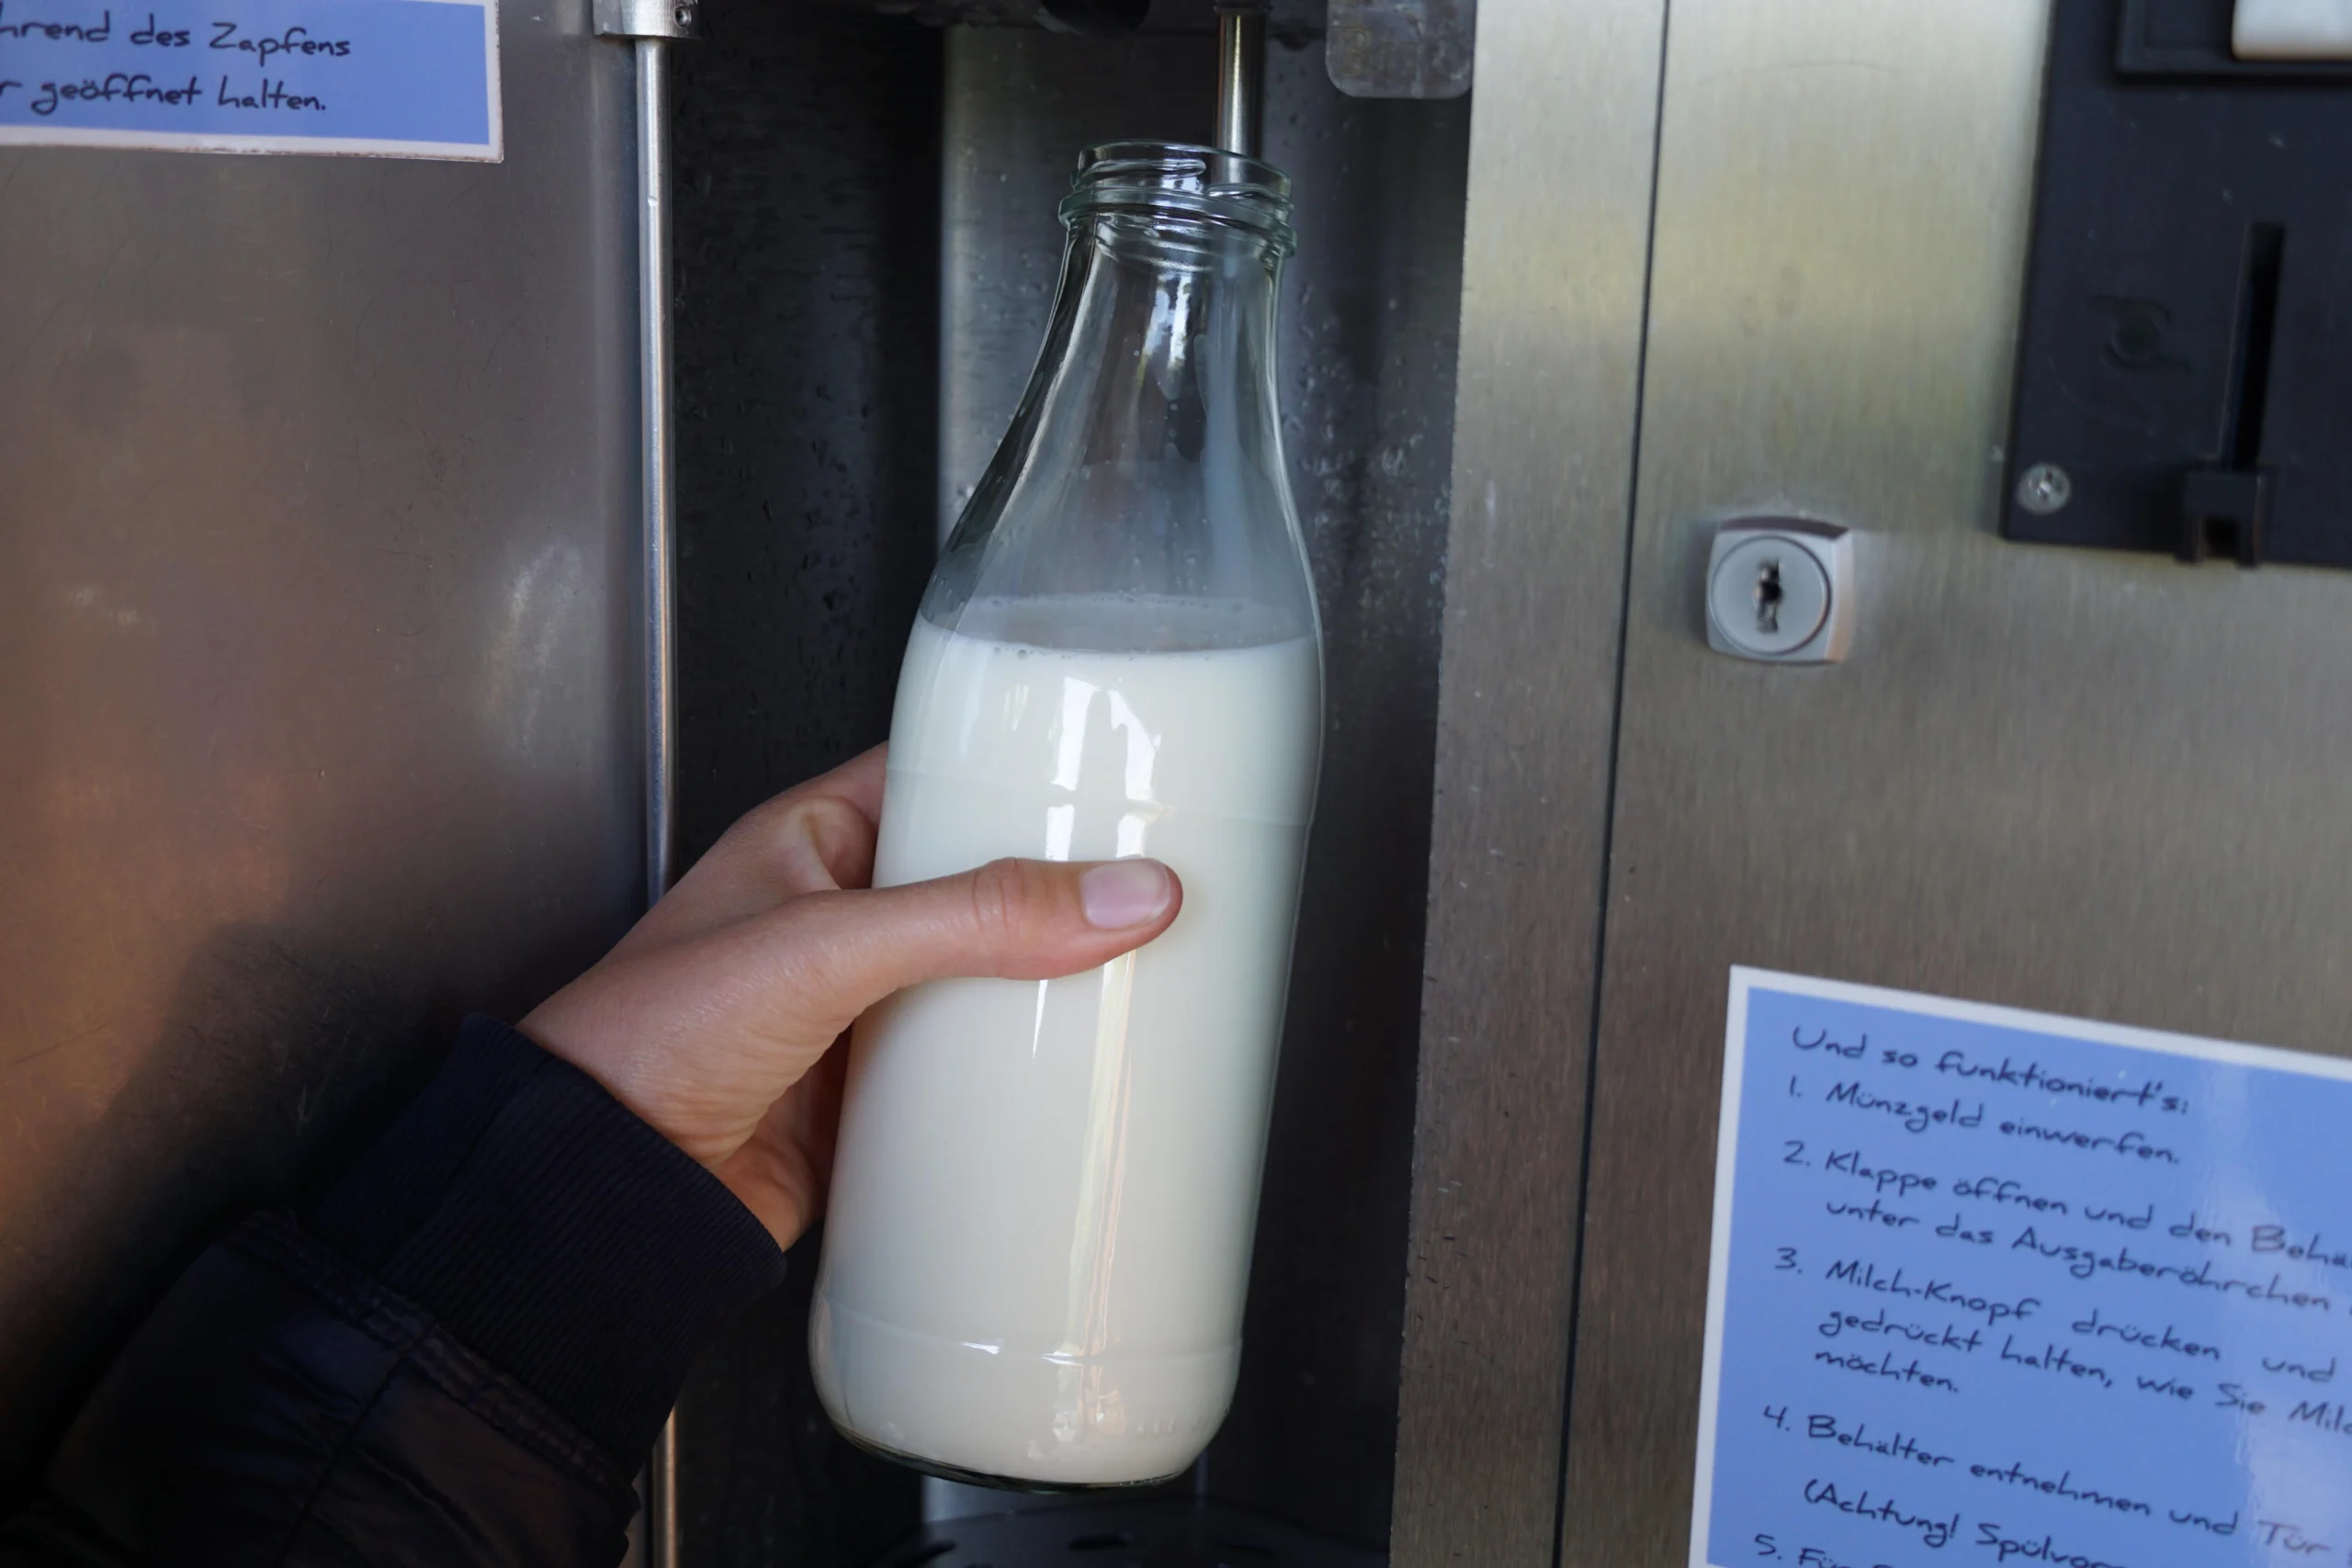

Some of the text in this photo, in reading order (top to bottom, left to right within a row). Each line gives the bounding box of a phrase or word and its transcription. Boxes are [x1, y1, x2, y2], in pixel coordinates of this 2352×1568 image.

[130, 12, 191, 48] des
[209, 22, 351, 68] Zapfens
[30, 73, 203, 117] geöffnet
[218, 74, 326, 110] halten.
[1792, 1026, 2188, 1115] Und so funktioniert's:
[1790, 1075, 2179, 1165] 1. Münzgeld einwerfen.
[1783, 1140, 2352, 1269] 2. Klappe öffnen und den Behä
[1826, 1199, 1921, 1229] unter
[1935, 1213, 1995, 1246] das
[2011, 1226, 2329, 1312] Ausgaberöhrchen
[1775, 1247, 2336, 1382] 3. Milch-Knopf drücken und
[1815, 1351, 1959, 1393] möchten.
[1818, 1308, 1983, 1352] gedrückt
[2000, 1335, 2113, 1389] halten,
[2137, 1376, 2195, 1401] wie
[2215, 1383, 2266, 1415] Sie
[1763, 1405, 2331, 1554] 4. Behälter entnehmen und Tür
[1804, 1478, 1961, 1549] (Achtung!
[1754, 1533, 1782, 1561] 5.
